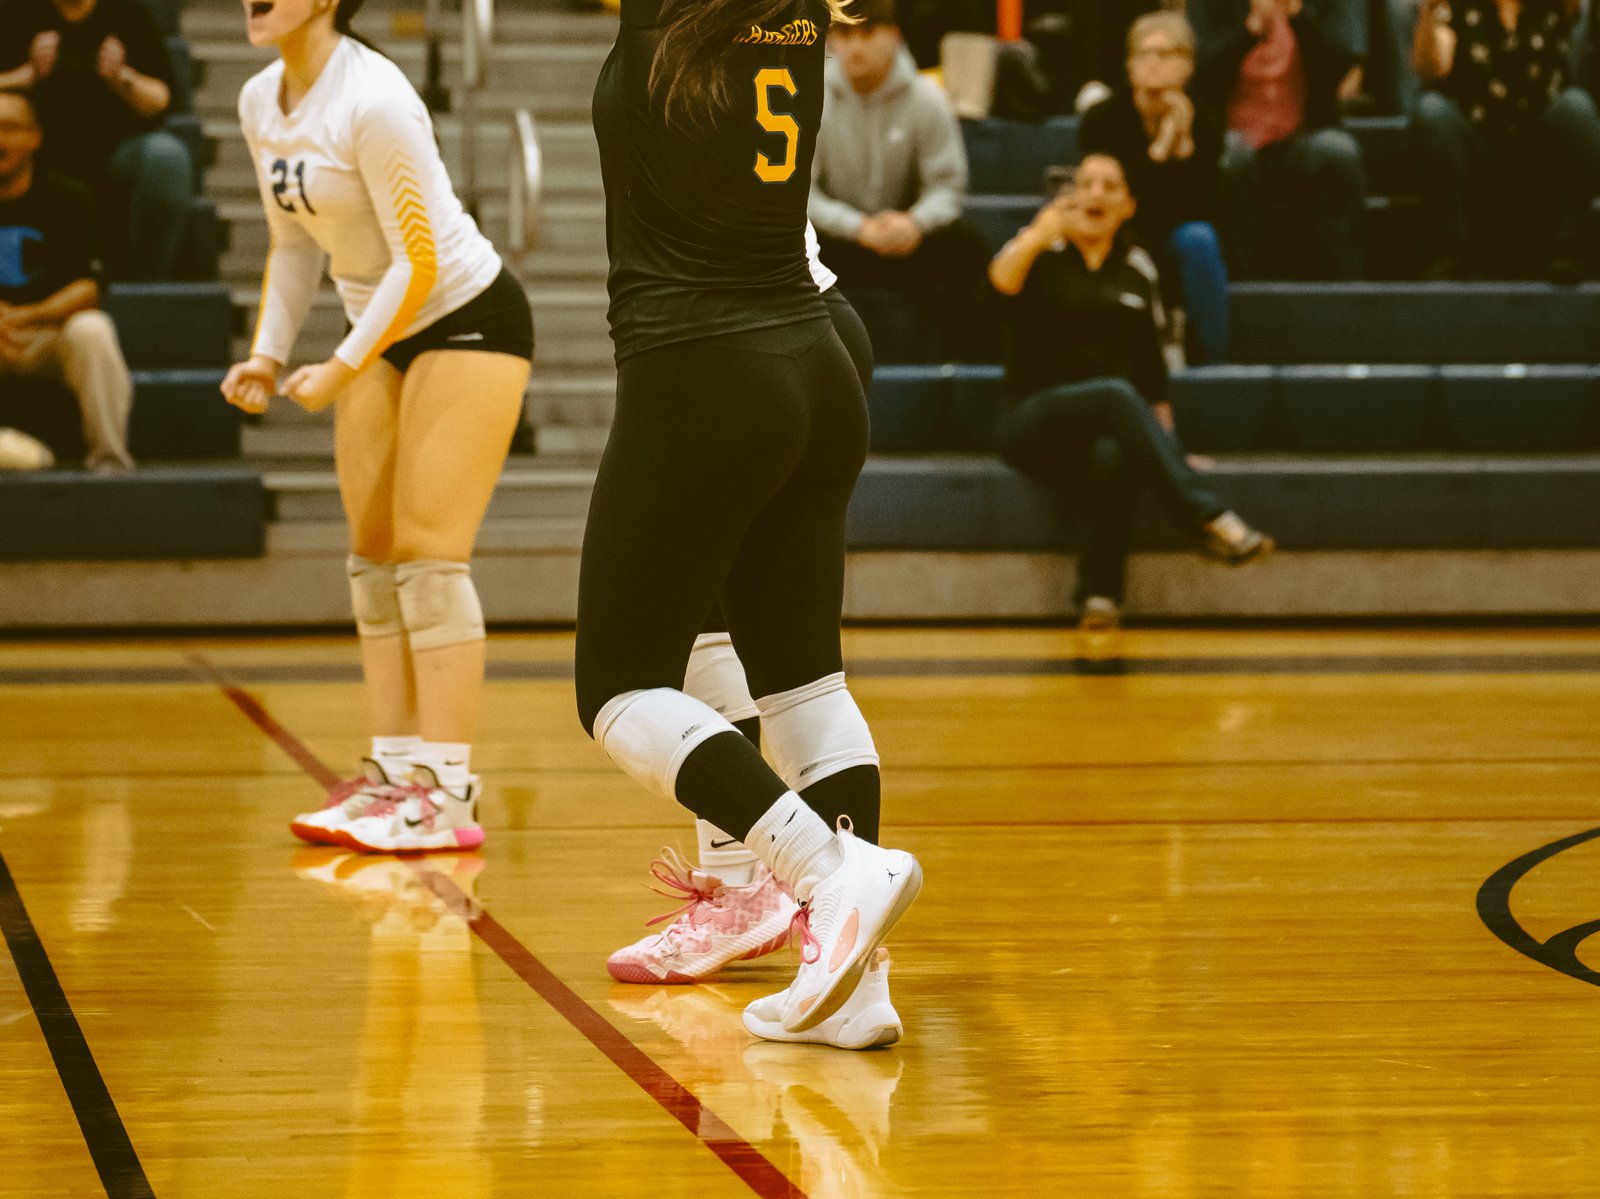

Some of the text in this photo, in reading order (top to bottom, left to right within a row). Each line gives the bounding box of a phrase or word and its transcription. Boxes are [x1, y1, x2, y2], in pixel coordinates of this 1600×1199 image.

[732, 19, 818, 46] HARGERS
[753, 67, 800, 183] 5
[271, 158, 317, 216] 21
